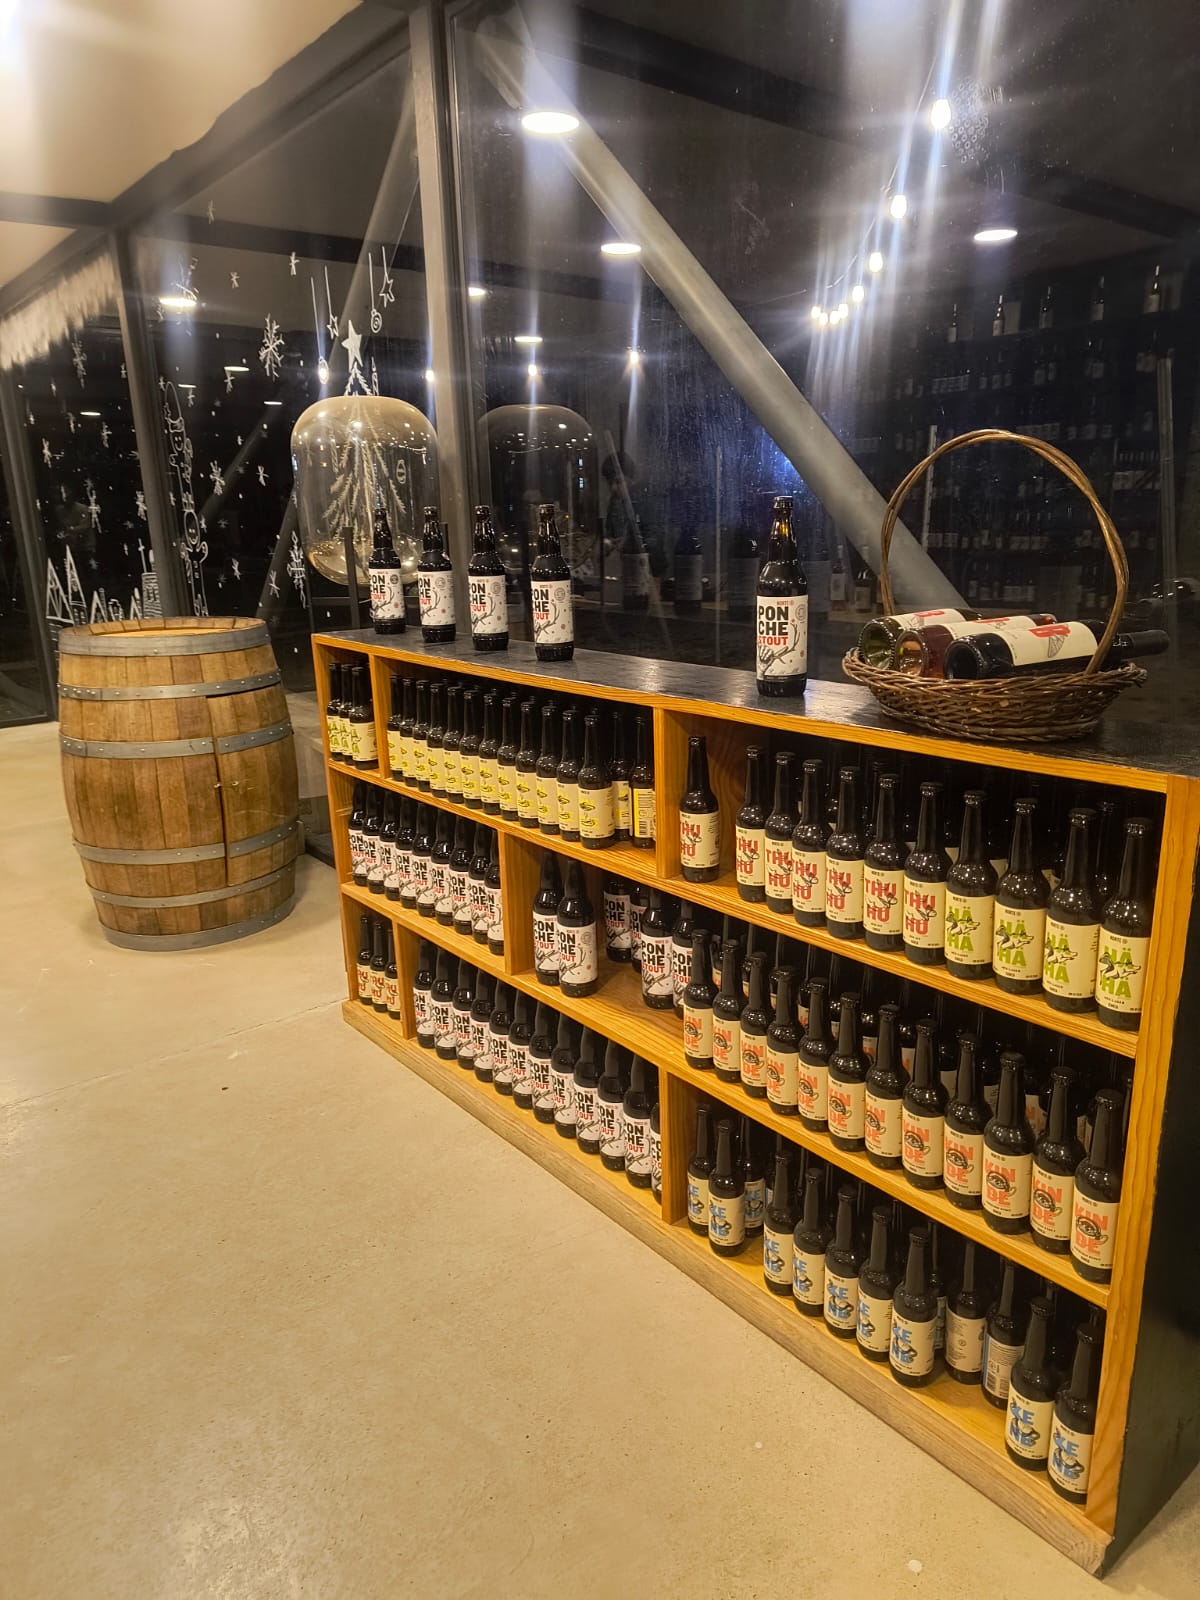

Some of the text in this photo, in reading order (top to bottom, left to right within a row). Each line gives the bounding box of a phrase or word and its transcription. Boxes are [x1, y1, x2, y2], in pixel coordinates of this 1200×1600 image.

[370, 574, 386, 585] ON
[419, 578, 431, 588] ON
[370, 584, 386, 594] HE
[419, 588, 431, 598] HE
[470, 583, 486, 594] ON
[532, 588, 549, 600] ON
[471, 594, 486, 605] HE
[533, 601, 549, 612] HE
[533, 612, 550, 620] TOUT
[758, 605, 789, 620] PON
[758, 621, 789, 636] CHE
[397, 855, 410, 864] ON
[398, 864, 410, 873] HE
[414, 861, 427, 871] ON
[415, 871, 427, 880] HE
[432, 868, 444, 878] ON
[433, 878, 444, 887] HE
[451, 876, 466, 886] ON
[452, 886, 466, 896] HE
[471, 885, 486, 895] ON
[471, 895, 486, 905] HE
[606, 899, 624, 911] ON
[606, 911, 624, 921] HE
[559, 931, 575, 944] ON
[559, 943, 576, 955] HE
[641, 941, 664, 954] PON
[641, 952, 665, 965] CHE
[434, 1006, 448, 1015] ON
[435, 1015, 449, 1024] HE
[455, 1015, 469, 1024] ON
[456, 1024, 470, 1033] HE
[493, 1039, 507, 1049] ON
[493, 1049, 507, 1058] HE
[511, 1049, 525, 1060] ON
[512, 1059, 526, 1069] HE
[533, 1063, 549, 1073] ON
[534, 1073, 549, 1083] HE
[577, 1092, 594, 1104] ON
[578, 1103, 594, 1114] HE
[599, 1105, 614, 1119] ON
[600, 1117, 615, 1129] HE
[627, 1123, 644, 1135] ON
[627, 1134, 644, 1146] HE
